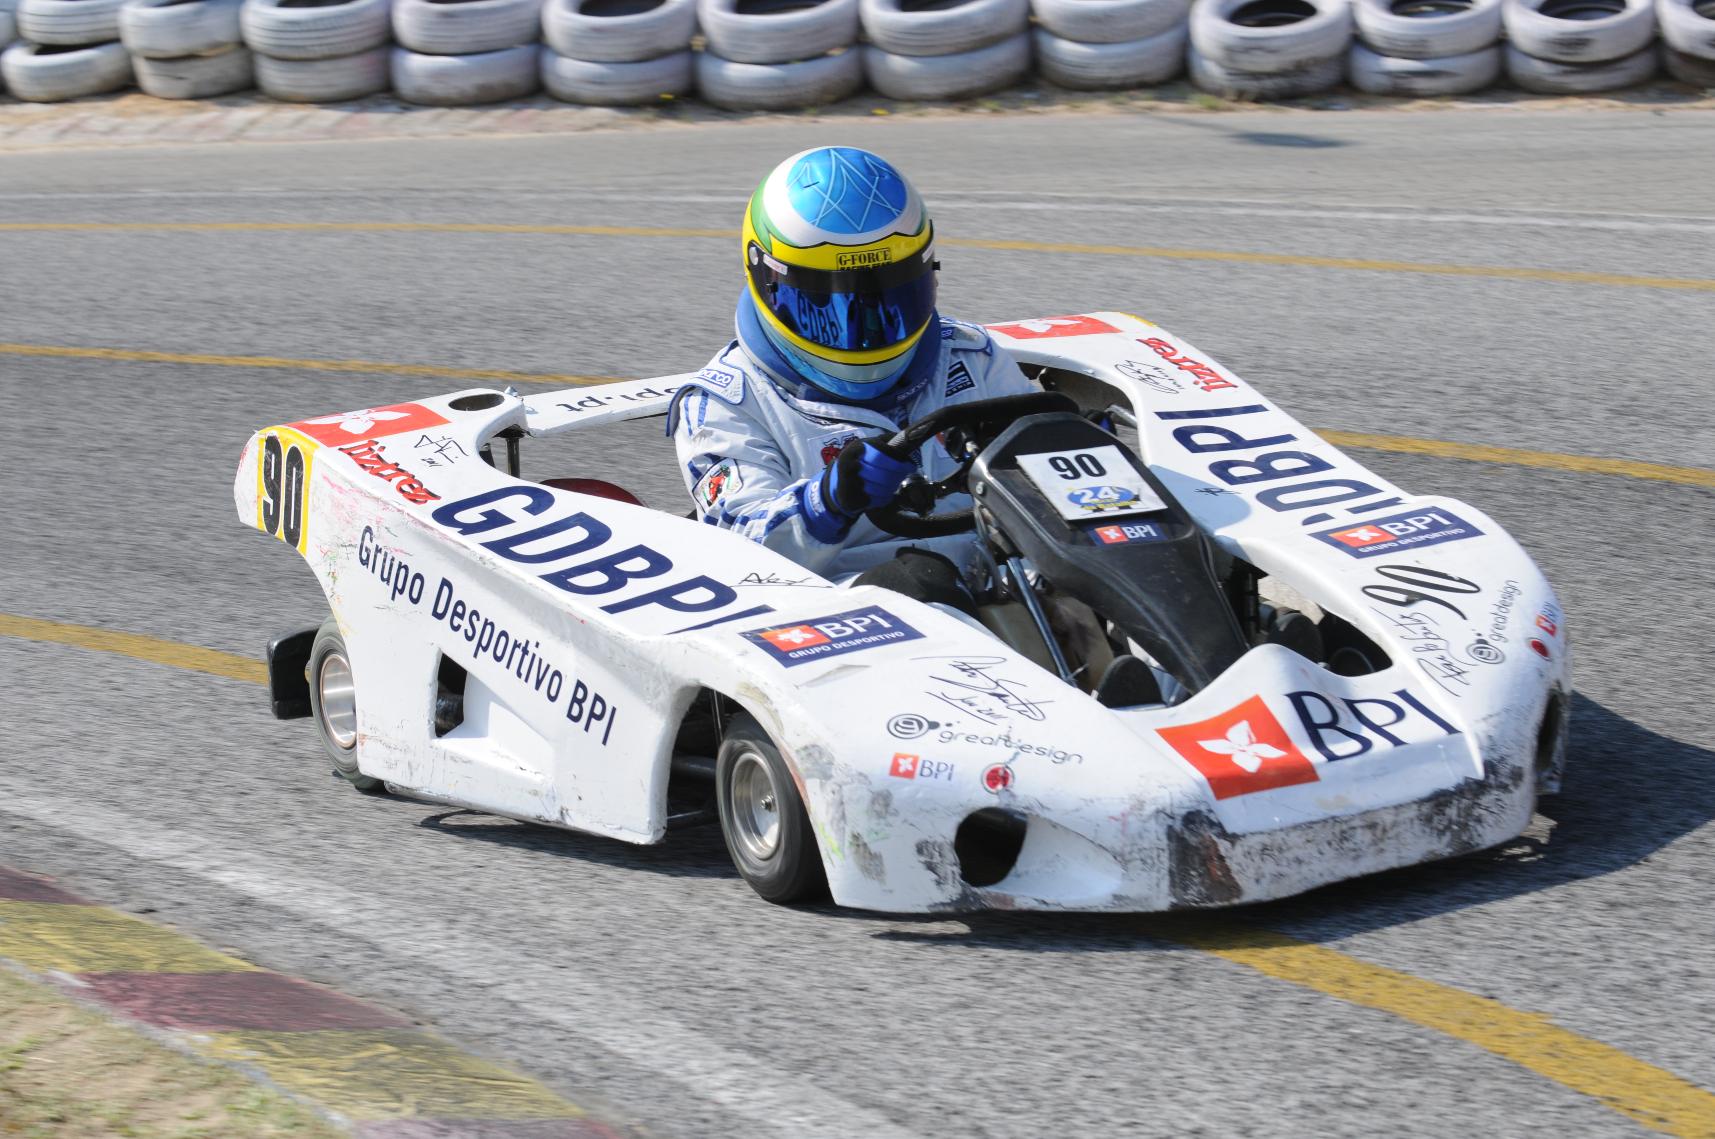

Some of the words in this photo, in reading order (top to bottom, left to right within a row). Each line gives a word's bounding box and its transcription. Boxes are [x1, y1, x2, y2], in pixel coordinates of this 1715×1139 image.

[839, 249, 889, 266] G-FORCE
[1048, 453, 1107, 480] 90
[263, 434, 304, 549] 90
[1121, 525, 1158, 539] BPI
[1380, 513, 1453, 536] BPI
[1358, 541, 1399, 553] GRUPO
[1400, 529, 1466, 545] DESPORTIVO
[1361, 564, 1481, 621] 90
[358, 525, 425, 605] Grupo
[431, 577, 563, 703] Desportivo
[566, 678, 617, 746] BPI
[814, 614, 893, 639] BPI
[788, 640, 832, 659] GRUPO
[832, 631, 905, 649] DESPORTIVO
[1284, 689, 1463, 762] BPI
[919, 758, 955, 782] BPI
